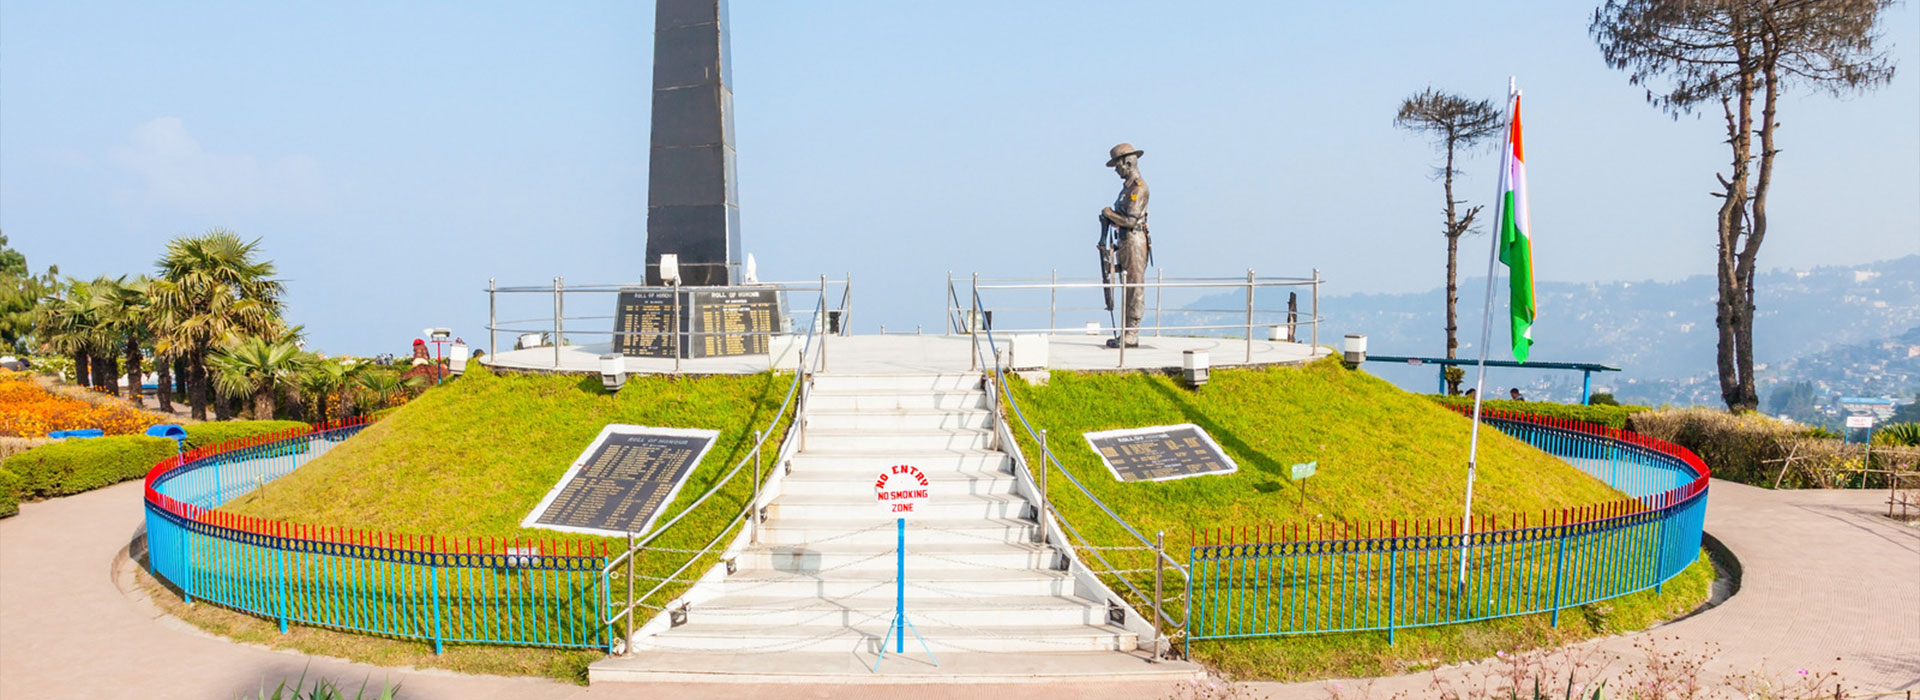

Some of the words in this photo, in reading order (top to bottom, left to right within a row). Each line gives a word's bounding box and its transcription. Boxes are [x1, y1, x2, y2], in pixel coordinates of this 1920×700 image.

[876, 473, 889, 489] NO
[892, 464, 929, 486] ENTRY
[878, 492, 889, 500] NO
[890, 489, 928, 500] SMOKING
[892, 503, 914, 512] ZONE
